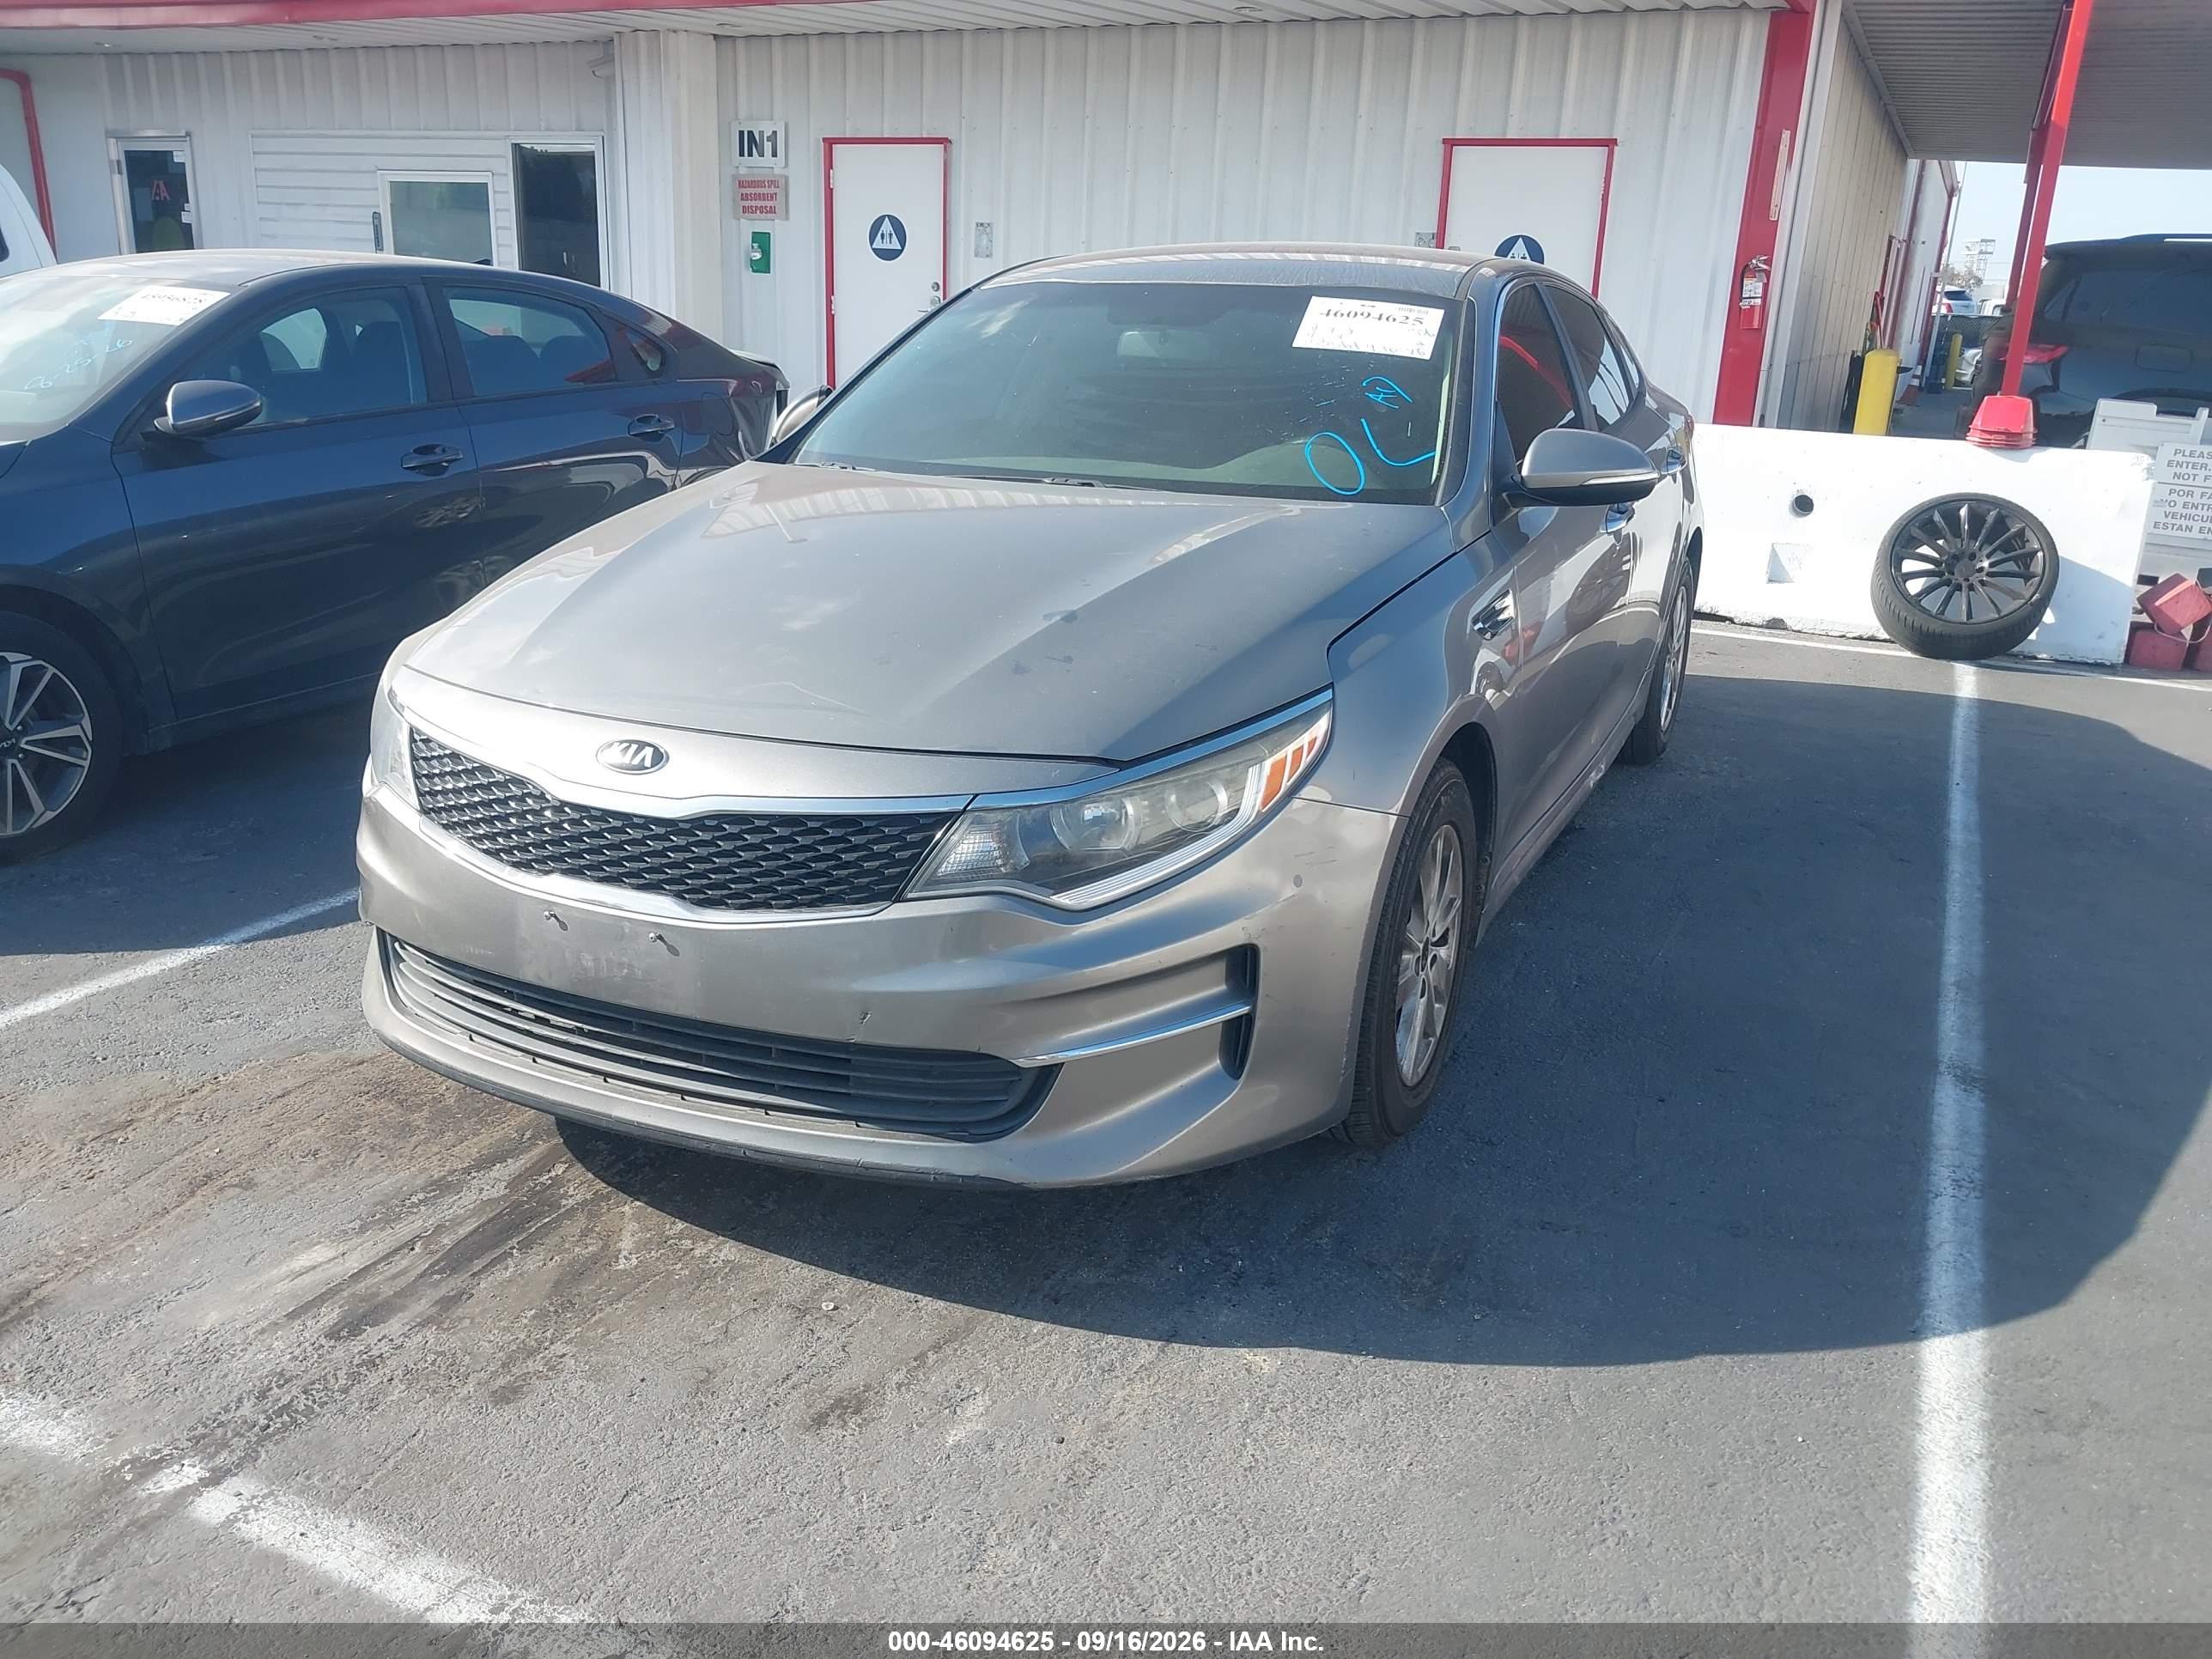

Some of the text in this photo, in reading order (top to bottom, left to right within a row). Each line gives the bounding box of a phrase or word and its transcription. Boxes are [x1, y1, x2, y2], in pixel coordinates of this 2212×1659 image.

[738, 130, 778, 158] IN1
[740, 191, 778, 202] ABSORBENT
[742, 205, 776, 215] DISPOSAL
[1320, 308, 1424, 326] 46094625
[2166, 459, 2211, 471] ENTER.
[2172, 471, 2199, 482] NOT
[2168, 488, 2195, 498] POR
[2153, 520, 2193, 533] ESTAN
[606, 740, 655, 769] KIA
